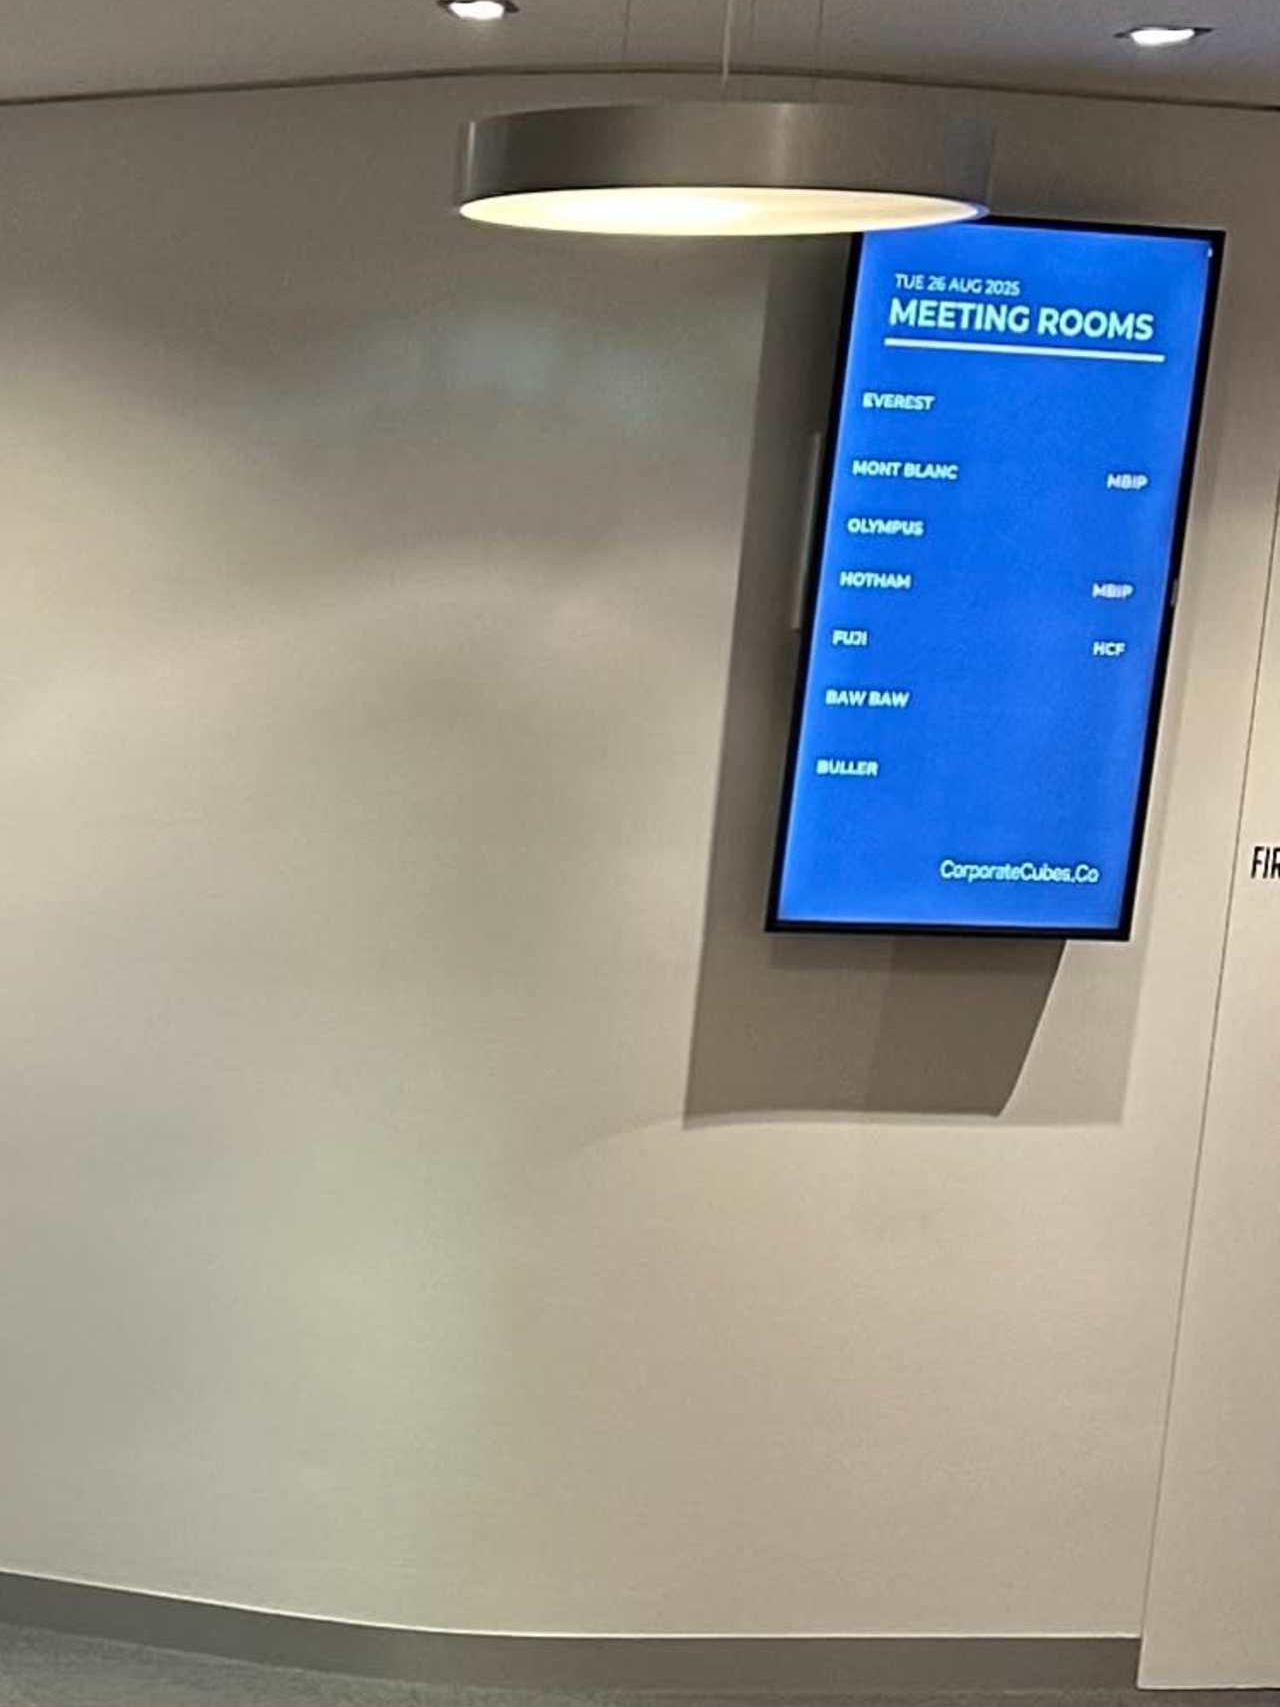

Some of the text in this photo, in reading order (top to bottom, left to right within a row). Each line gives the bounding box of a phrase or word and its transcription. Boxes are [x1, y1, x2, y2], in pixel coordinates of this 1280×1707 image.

[895, 273, 1020, 296] TUE 26 AUG 2025
[889, 297, 1154, 341] MEETING ROOMS
[862, 392, 935, 410] EVEREST
[852, 460, 958, 480] MONT BLANC
[847, 518, 924, 536] OLYMPUS
[839, 571, 911, 589] HOTHAM
[832, 629, 868, 646] FUJI
[1092, 641, 1126, 656] HCF
[825, 689, 910, 708] BAW BAW
[816, 759, 879, 776] BULLER
[940, 859, 1100, 883] CorporateCubes.Co
